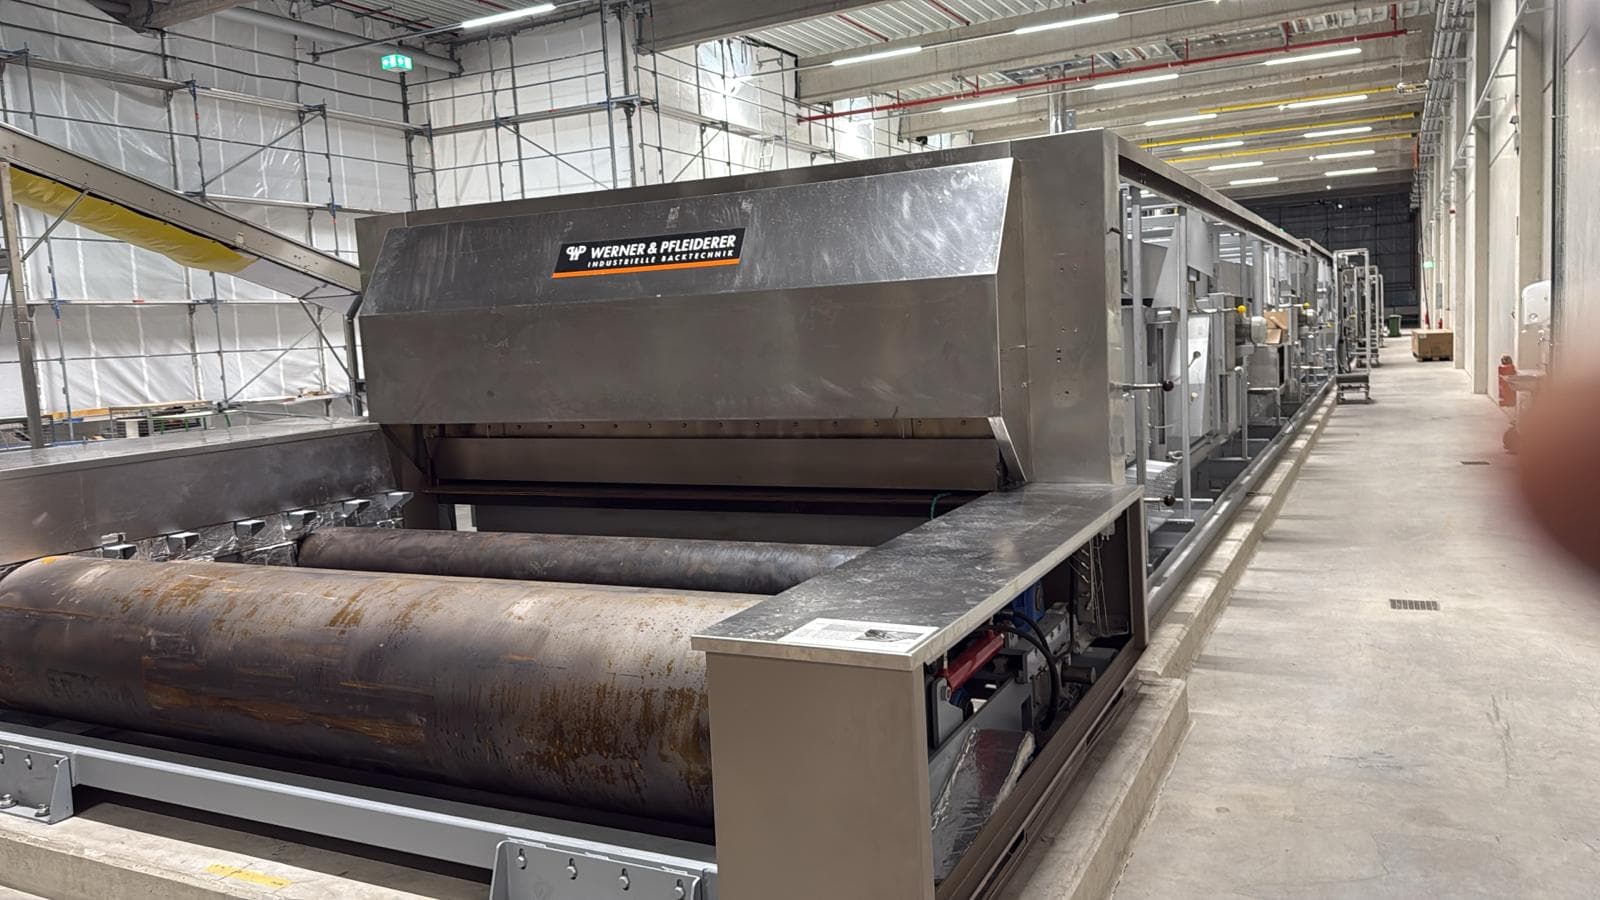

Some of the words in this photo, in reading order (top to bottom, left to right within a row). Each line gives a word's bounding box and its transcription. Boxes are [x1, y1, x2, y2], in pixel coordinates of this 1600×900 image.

[591, 243, 645, 259] WERNER
[647, 242, 658, 254] &
[660, 235, 736, 254] PFLEIDERER
[588, 256, 656, 268] INDUSTRIELLE
[661, 250, 734, 262] BACKTECHNIK
